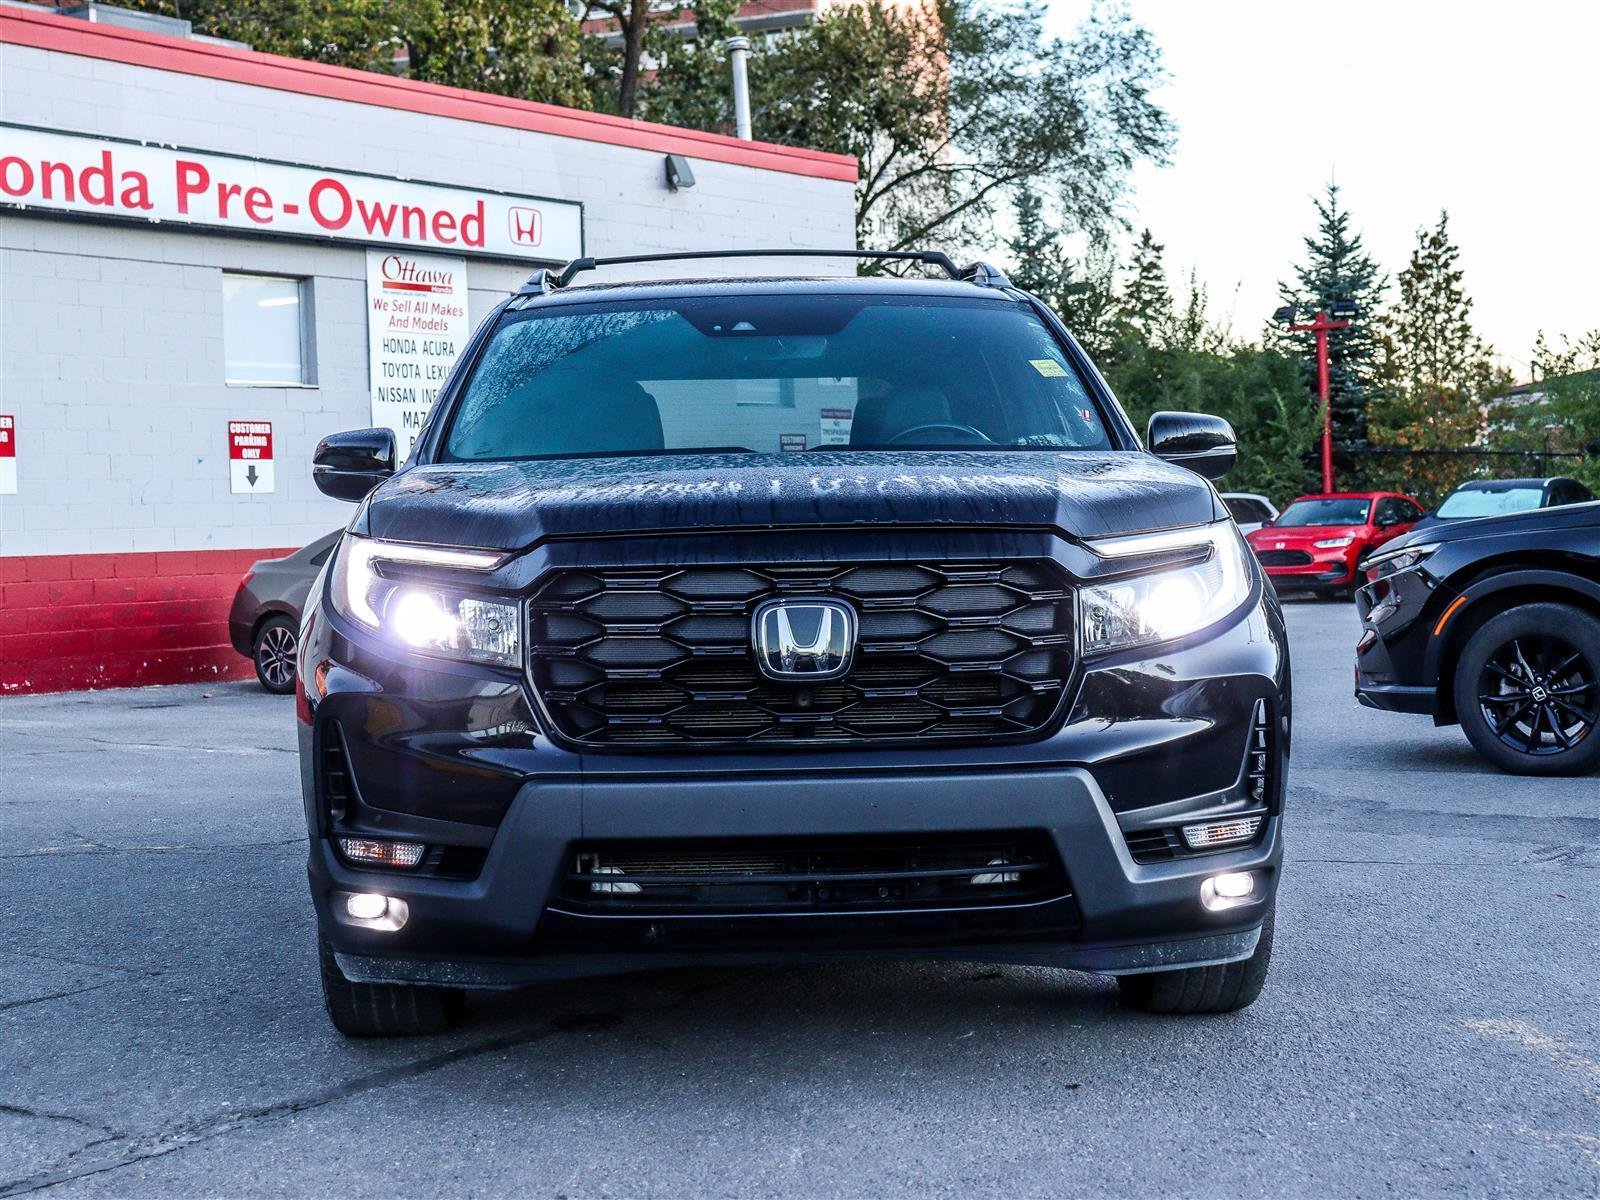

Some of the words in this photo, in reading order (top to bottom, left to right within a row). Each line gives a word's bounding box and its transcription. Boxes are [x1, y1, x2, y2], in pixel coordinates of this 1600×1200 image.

[176, 160, 485, 247] Pre-Owned
[382, 254, 453, 285] Ottawa
[373, 298, 389, 311] We
[392, 299, 412, 313] Sell
[414, 301, 429, 314] All
[431, 302, 464, 317] Makes
[389, 315, 410, 329] And
[412, 316, 449, 331] Models
[383, 338, 417, 354] HONDA
[422, 341, 455, 356] ACURA
[382, 362, 421, 379] TOYOTA
[426, 365, 453, 380] LEXU
[378, 386, 416, 403] NISSAN
[422, 389, 438, 403] INF
[230, 422, 271, 434] CUSTOMER
[234, 434, 268, 447] PARKING
[241, 447, 261, 459] ONLY
